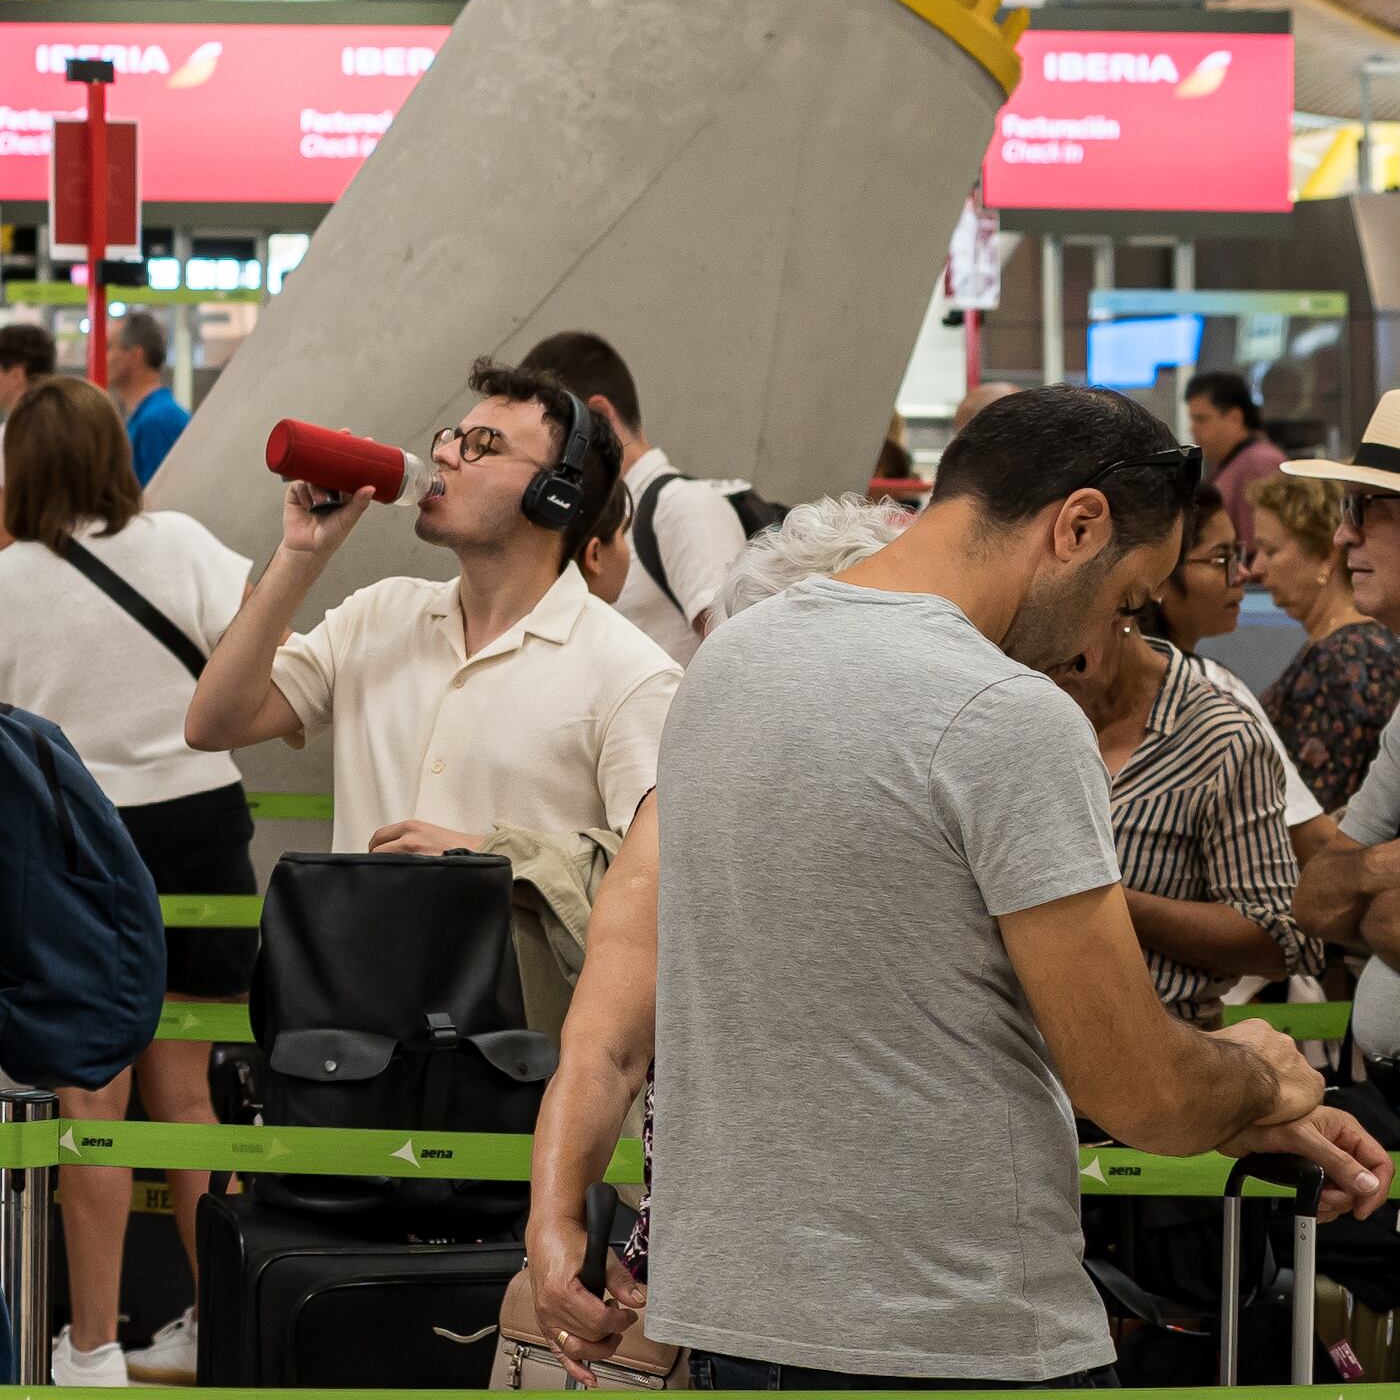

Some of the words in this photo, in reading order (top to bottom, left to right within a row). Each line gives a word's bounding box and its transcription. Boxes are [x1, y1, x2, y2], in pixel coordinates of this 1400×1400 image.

[1043, 52, 1179, 83] IBERIA
[81, 1137, 113, 1148] aena
[420, 1148, 454, 1159] aena
[1108, 1166, 1142, 1177] aena
